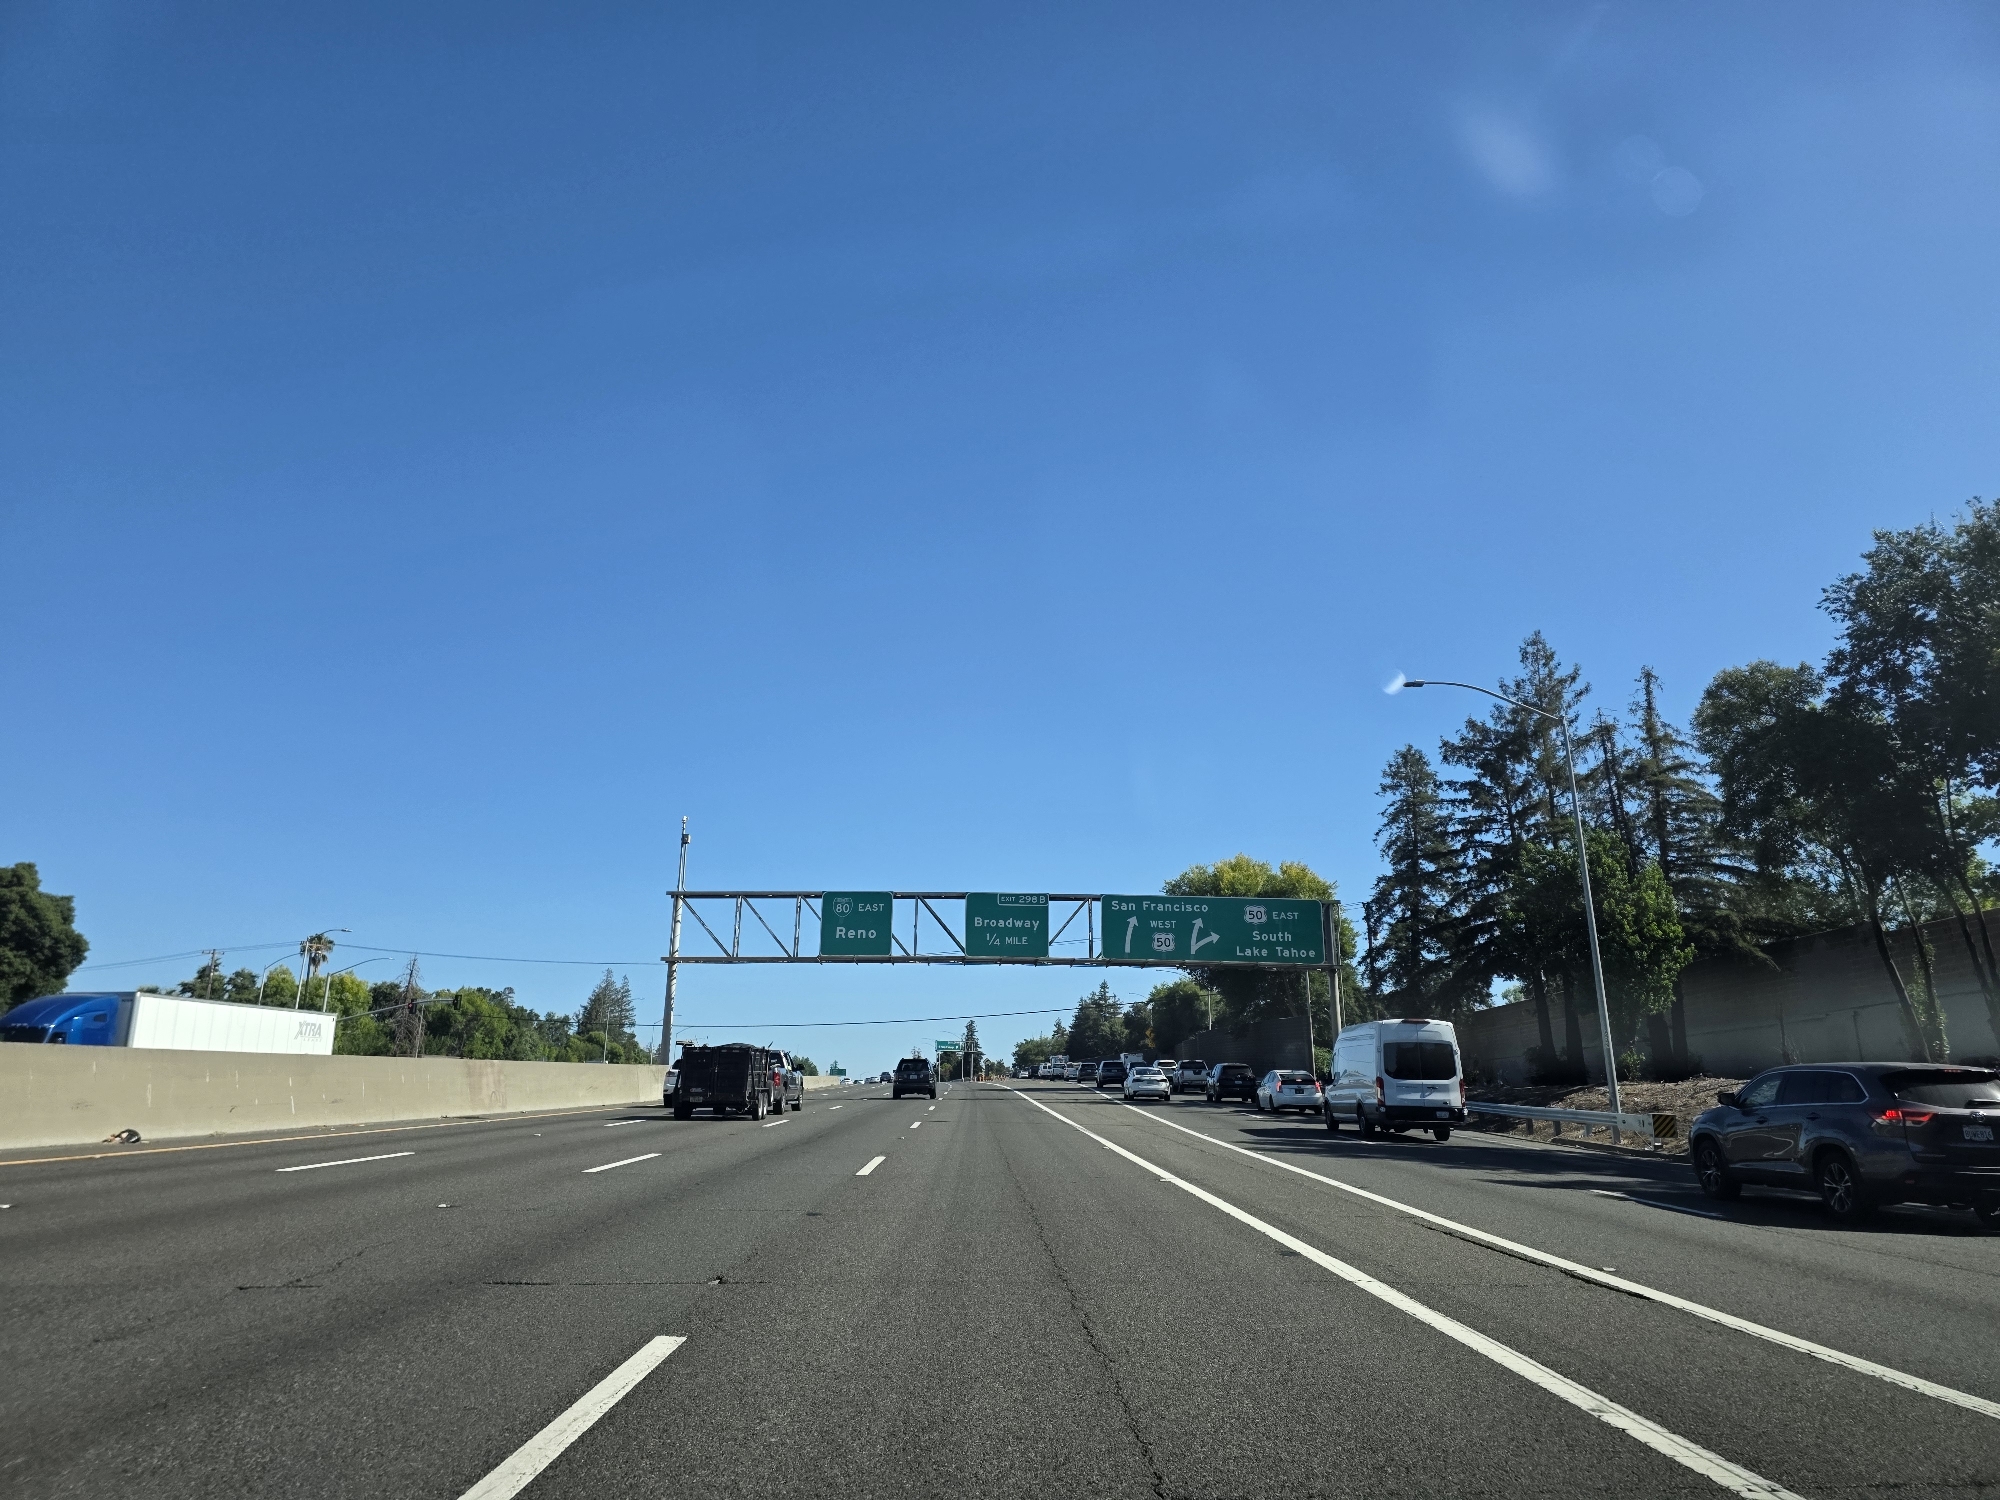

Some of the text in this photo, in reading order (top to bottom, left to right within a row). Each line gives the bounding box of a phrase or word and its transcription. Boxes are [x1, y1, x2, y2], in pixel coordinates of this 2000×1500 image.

[836, 903, 885, 913] 80 EAST
[1111, 900, 1209, 913] San Francisco
[1248, 910, 1299, 920] 50 EAST
[974, 916, 1040, 931] Broadway
[1149, 920, 1177, 929] WEST
[835, 926, 877, 939] Reno
[1252, 930, 1292, 942] South
[1005, 936, 1029, 945] MILE
[1156, 937, 1171, 948] 50
[1236, 945, 1316, 958] Lake Tahoe
[294, 1020, 322, 1040] XTRA
